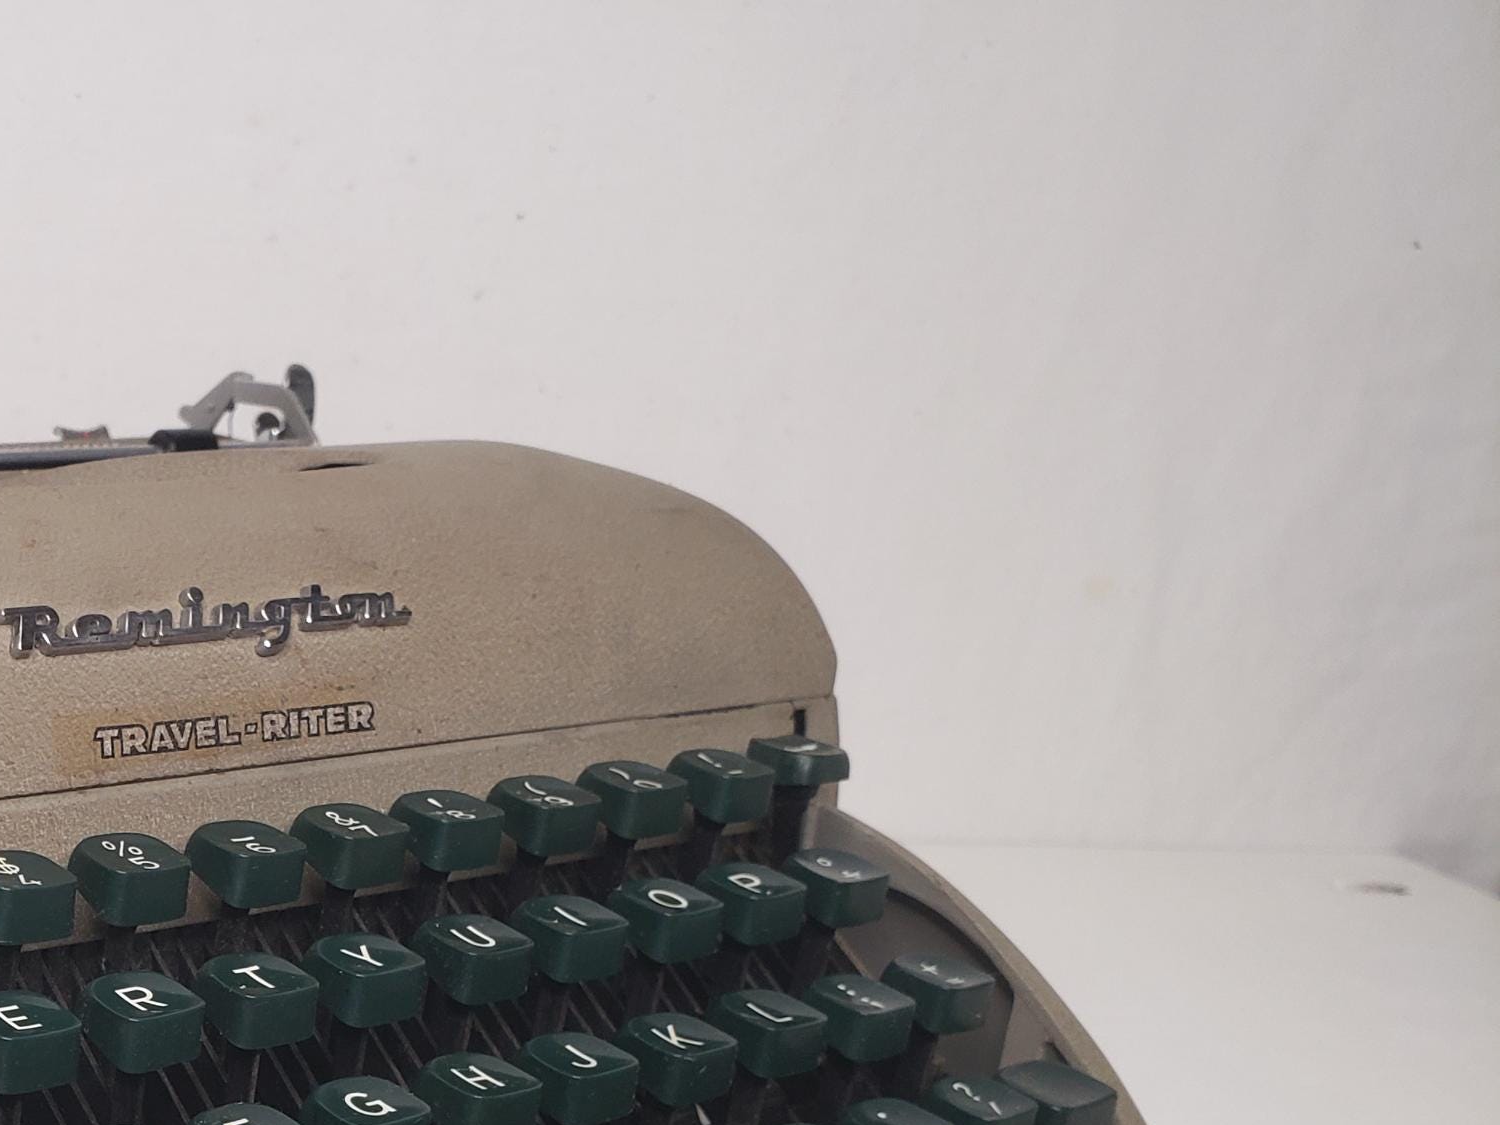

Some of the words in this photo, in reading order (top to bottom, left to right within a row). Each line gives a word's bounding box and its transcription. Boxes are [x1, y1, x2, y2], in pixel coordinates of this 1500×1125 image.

[94, 702, 375, 758] TRAVEL-RITER
[727, 873, 762, 894] P
[647, 889, 689, 909] O
[553, 906, 587, 926] I
[450, 925, 496, 948] U
[340, 944, 384, 967] Y
[232, 964, 275, 989] T
[114, 986, 168, 1011] R
[746, 1002, 793, 1023] L
[651, 1024, 704, 1049] K
[564, 1044, 598, 1068] J
[450, 1065, 506, 1090] H
[344, 1092, 397, 1116] G
